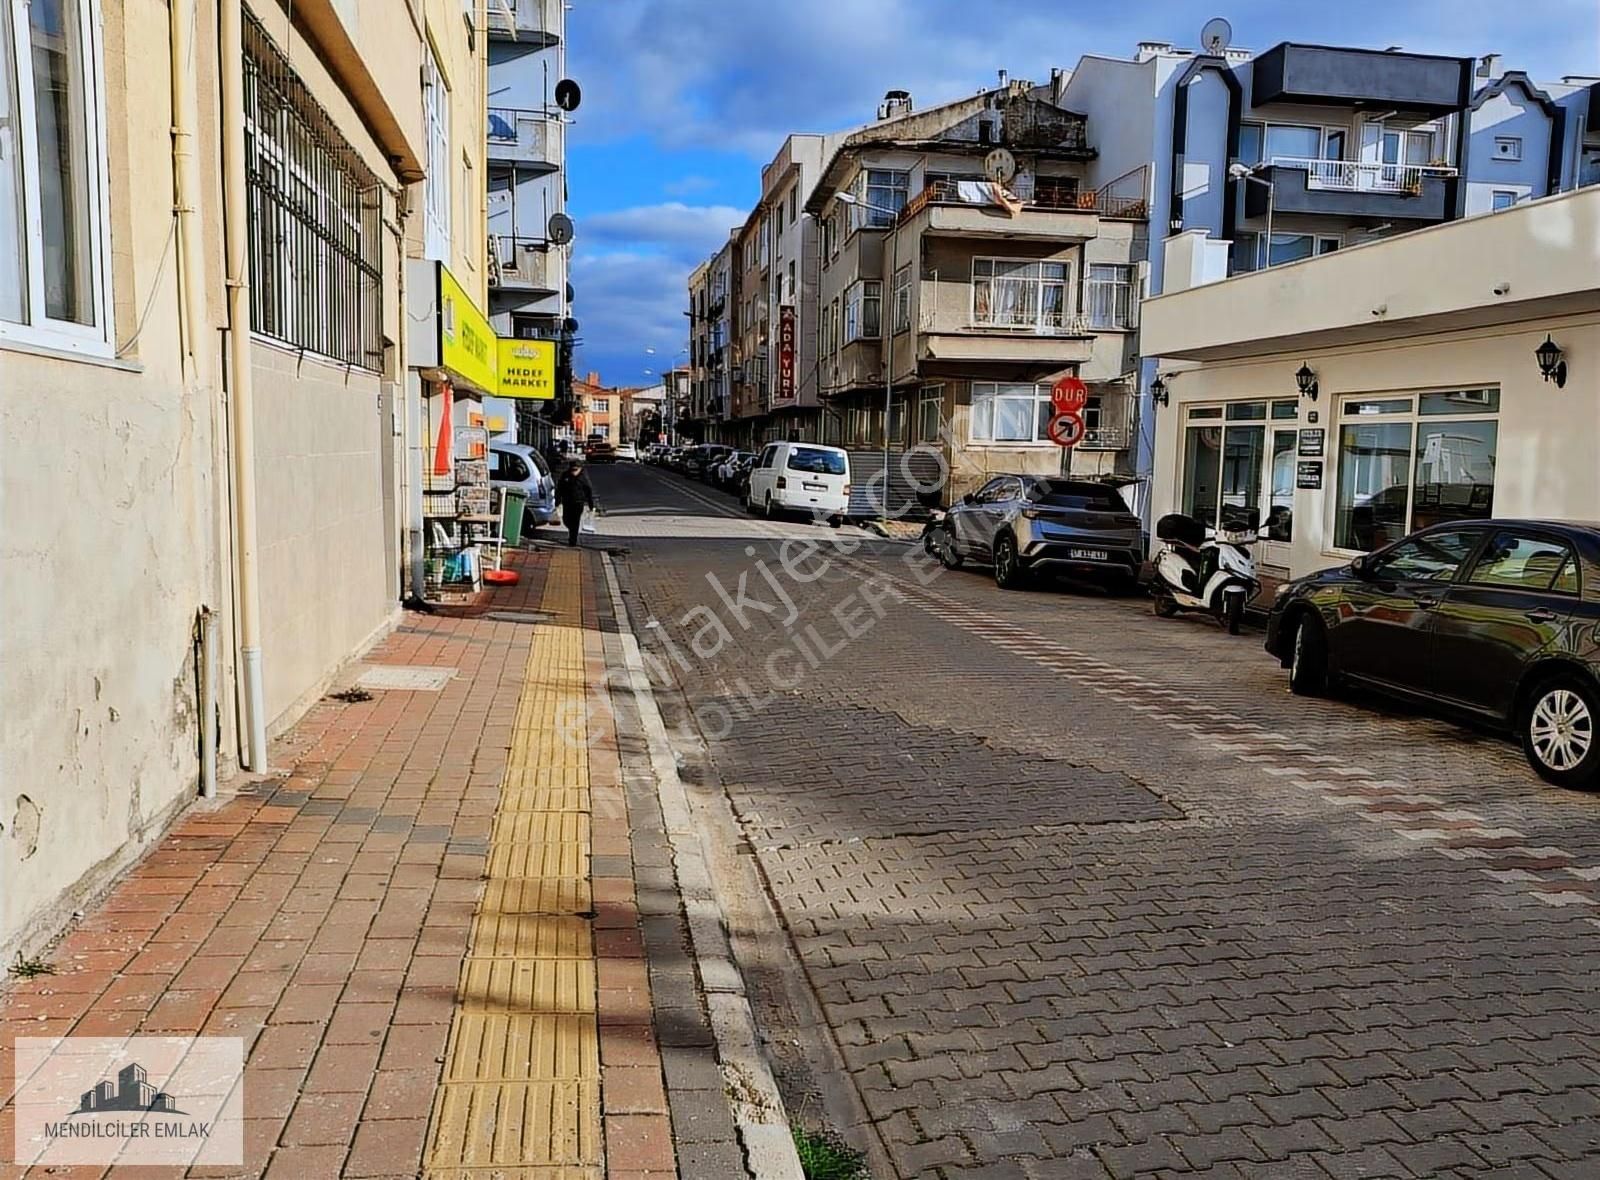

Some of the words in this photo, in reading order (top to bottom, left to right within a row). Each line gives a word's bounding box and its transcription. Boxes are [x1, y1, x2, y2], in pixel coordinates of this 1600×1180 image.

[507, 367, 543, 377] HEDEF
[502, 378, 548, 388] MARKET
[1055, 388, 1084, 402] DUR
